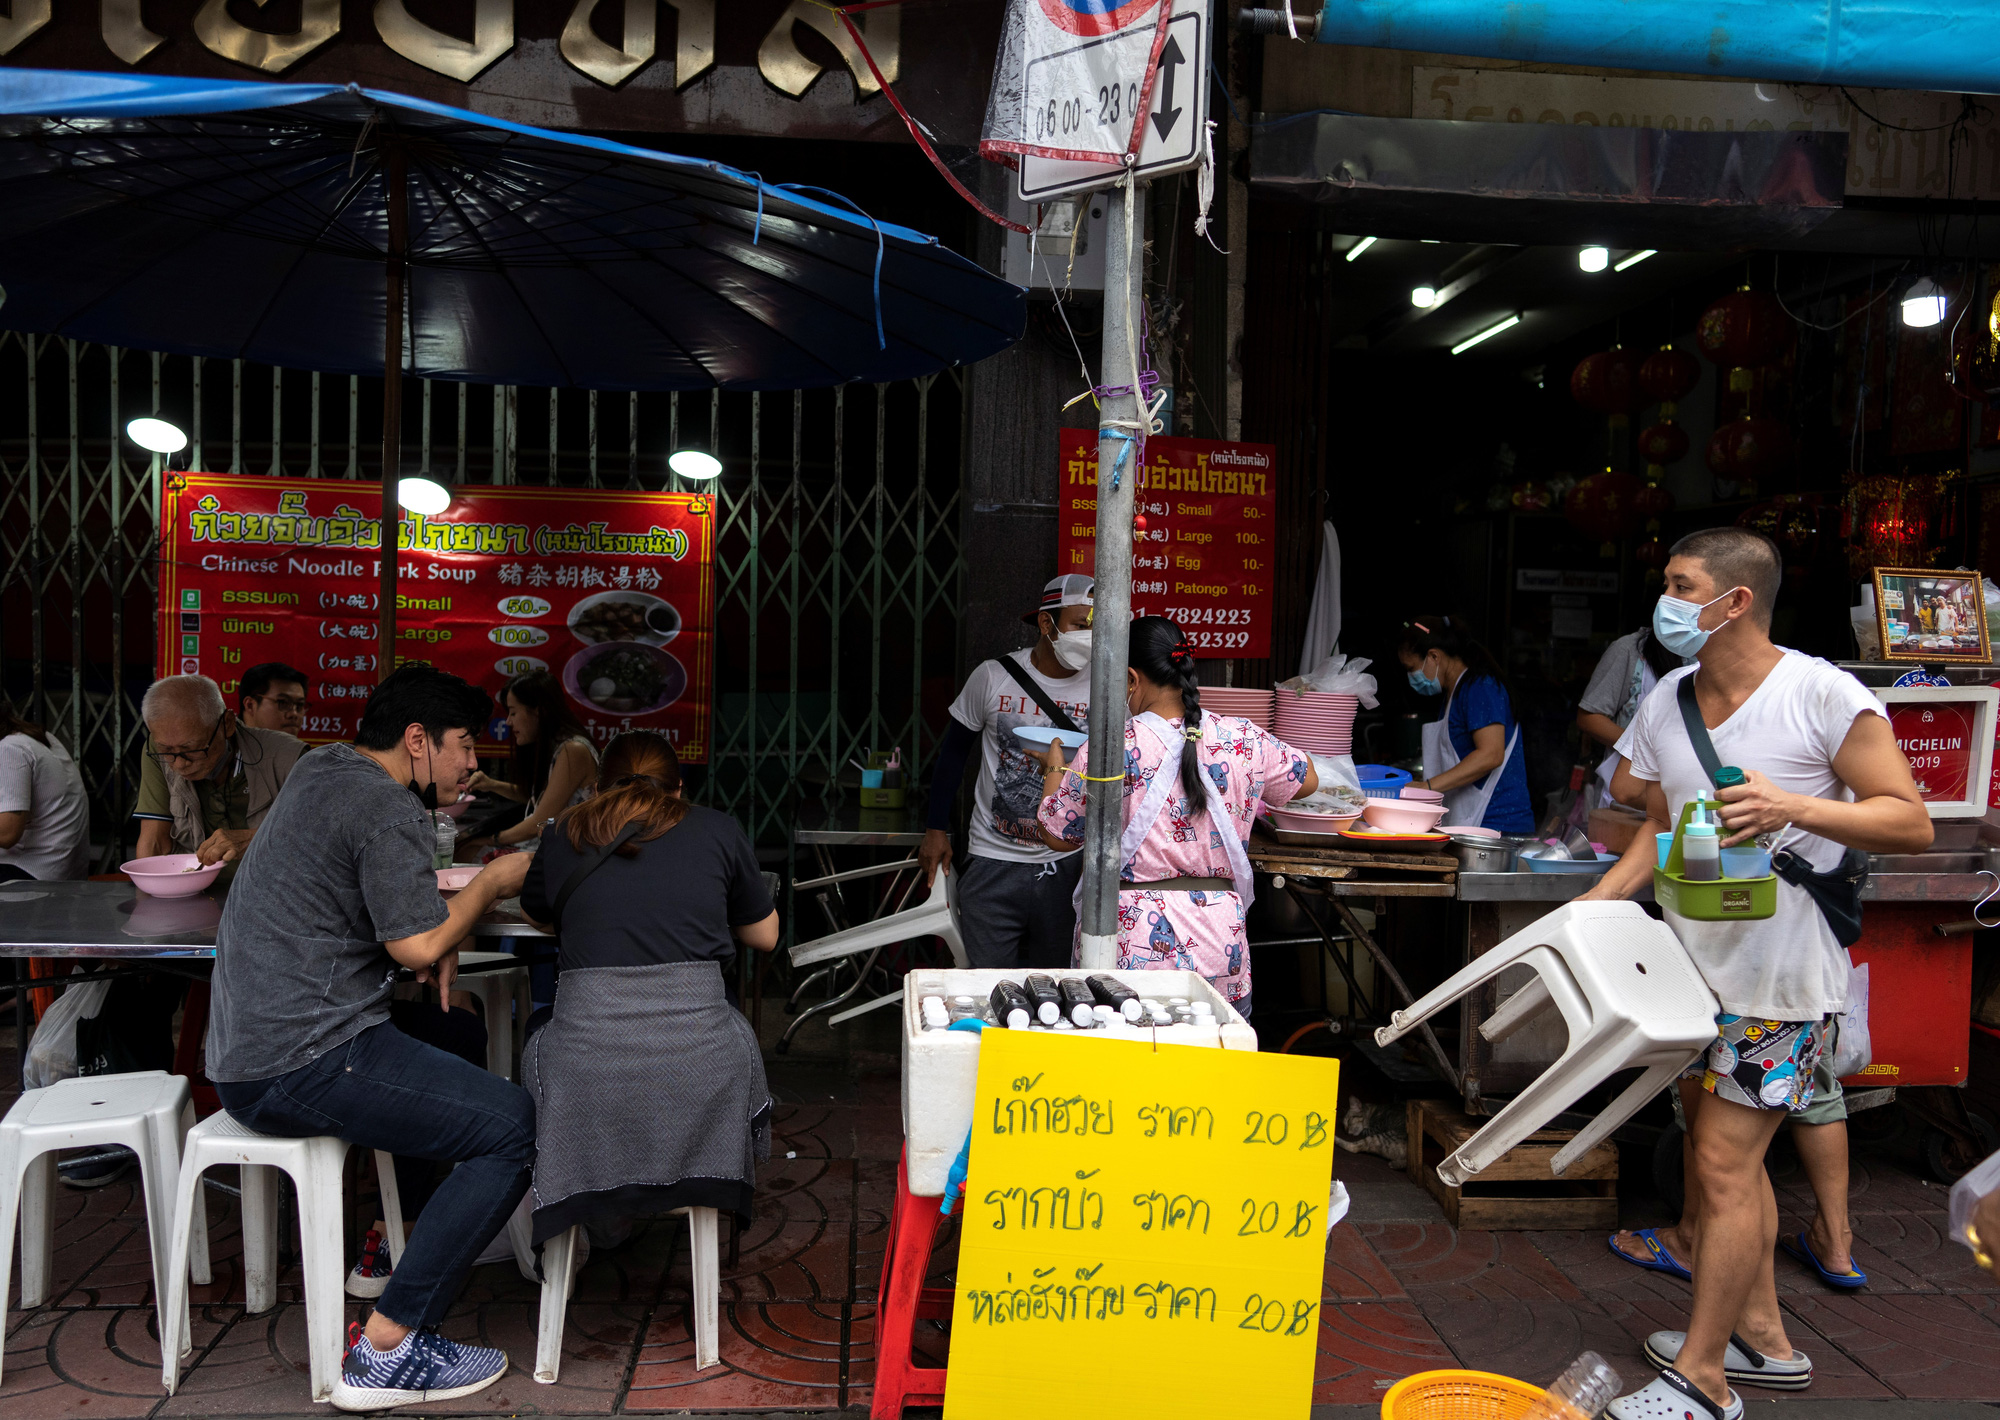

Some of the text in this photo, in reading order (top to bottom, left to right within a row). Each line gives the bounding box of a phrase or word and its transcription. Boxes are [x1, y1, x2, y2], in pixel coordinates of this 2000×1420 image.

[1176, 503, 1267, 519] Small 50.-
[1176, 530, 1266, 545] Large 100.-
[201, 554, 476, 584] Chinese Noodle Prk Soup
[1176, 556, 1264, 571] Egg 10.-
[222, 590, 299, 604] ธรรมดา
[1175, 582, 1264, 598] Patongo 10.-
[395, 594, 452, 611] Small
[507, 598, 549, 615] 50.-
[222, 617, 275, 634] พิเศษ
[491, 629, 547, 645] 100.-
[1910, 756, 1941, 769] 2019
[993, 1072, 1114, 1136] เก๊กฮวย
[1138, 1102, 1214, 1141] ราคา
[983, 1168, 1104, 1231] รากบัว
[1132, 1189, 1211, 1235] ราคา
[1133, 1280, 1217, 1322] ราคา
[1662, 1369, 1688, 1389] ADDA
